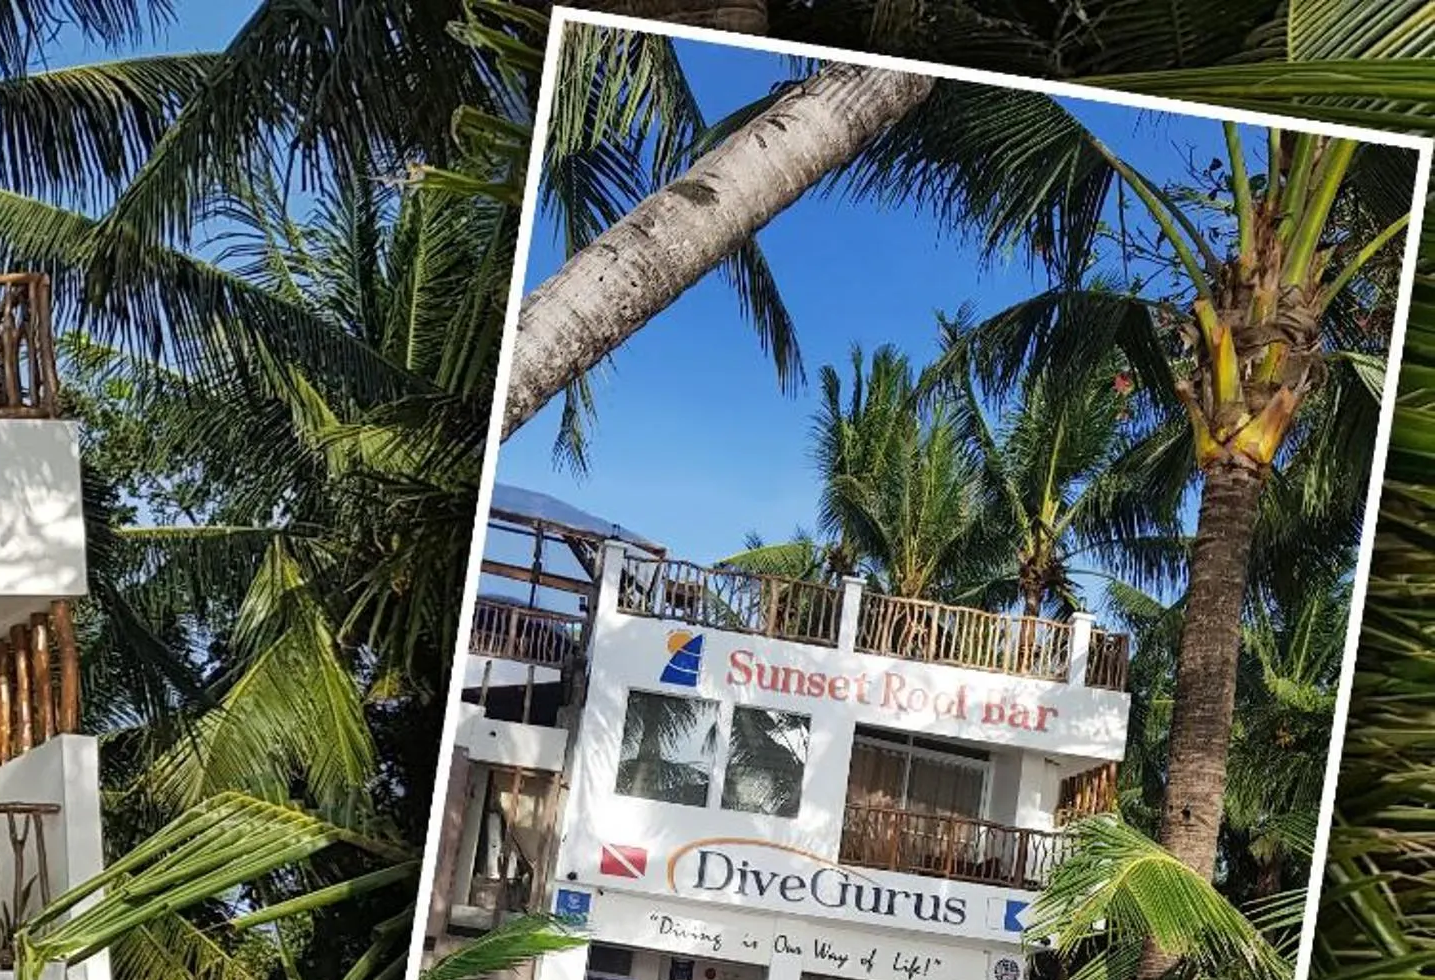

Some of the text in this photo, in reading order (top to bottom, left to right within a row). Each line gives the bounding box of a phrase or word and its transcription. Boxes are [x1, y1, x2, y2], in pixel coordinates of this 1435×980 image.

[726, 649, 871, 704] Sunset
[693, 850, 967, 925] DiveGurus
[814, 939, 849, 968] Way
[861, 948, 877, 973] of
